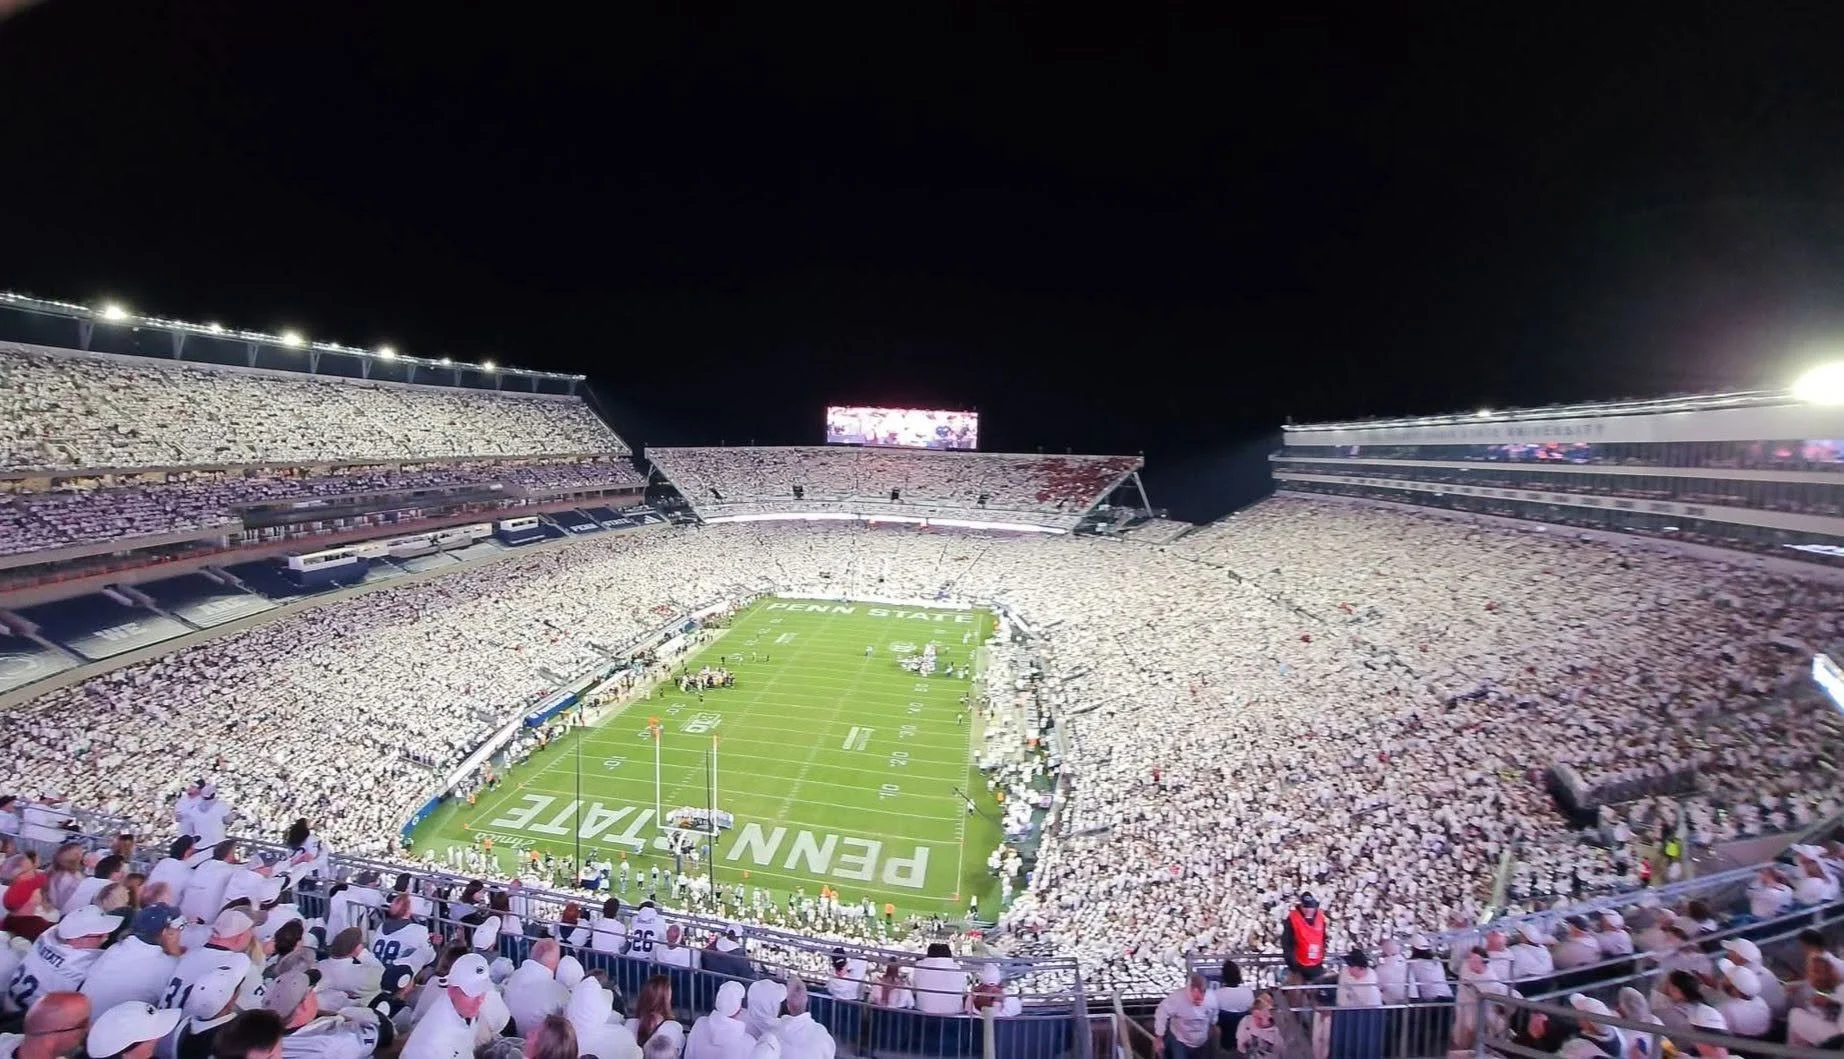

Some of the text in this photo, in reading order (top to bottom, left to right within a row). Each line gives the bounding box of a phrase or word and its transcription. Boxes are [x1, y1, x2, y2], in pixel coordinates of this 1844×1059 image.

[766, 602, 975, 624] PENN STATE
[489, 793, 931, 889] PENN TATE
[632, 929, 655, 952] 26
